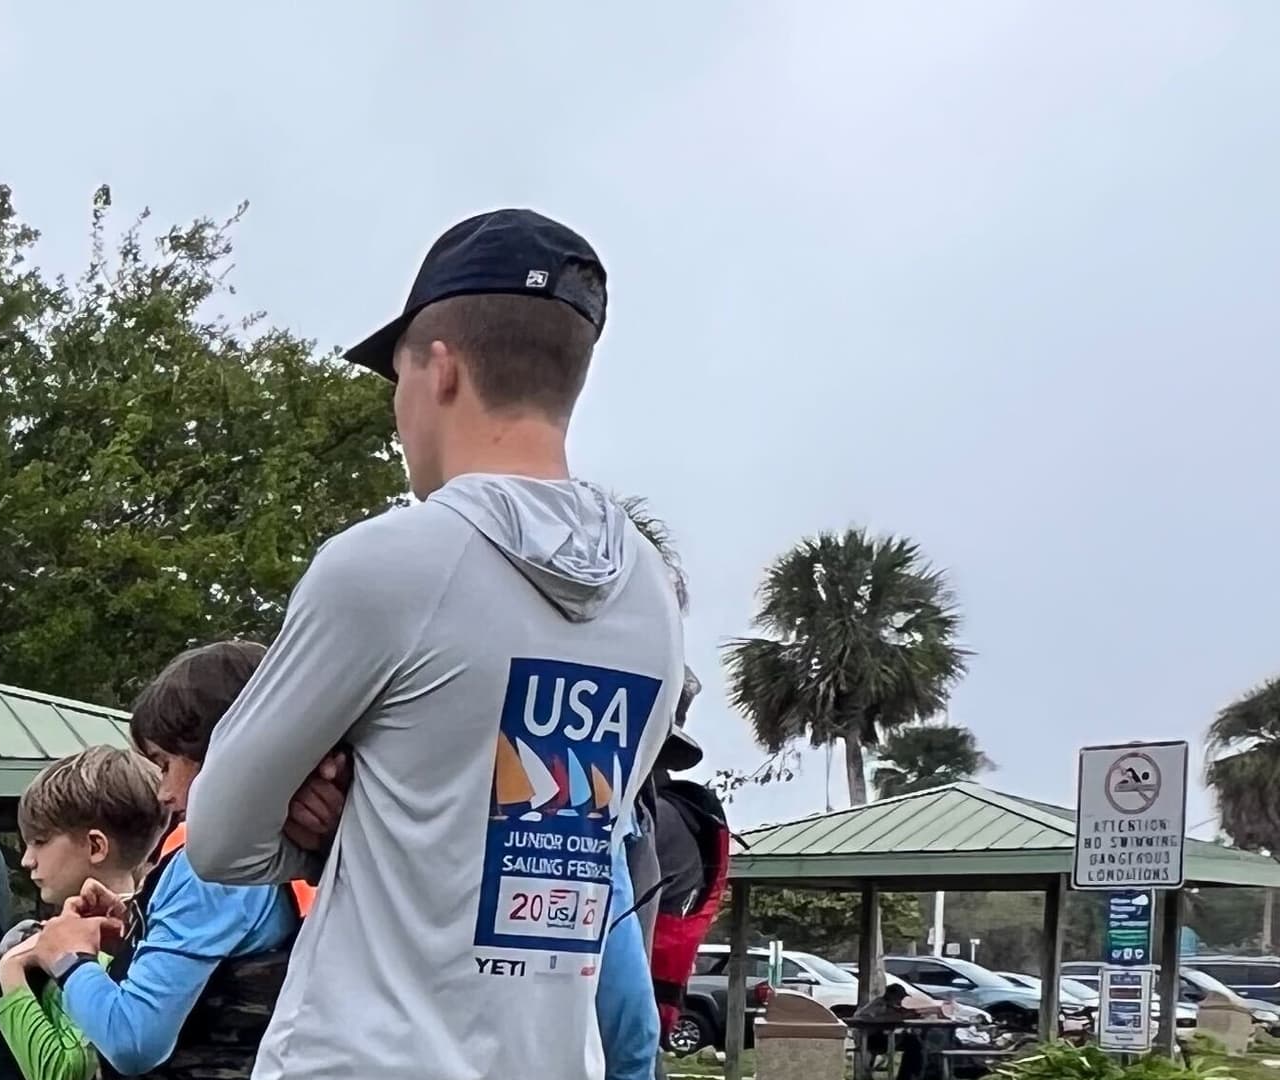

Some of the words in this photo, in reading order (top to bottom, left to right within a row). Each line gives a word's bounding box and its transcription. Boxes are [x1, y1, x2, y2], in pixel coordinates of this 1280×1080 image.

[523, 675, 628, 748] USA
[503, 831, 563, 850] JUNIOR
[1083, 836, 1102, 849] NO
[1110, 834, 1178, 849] SWIMMING
[501, 855, 564, 876] SAILING
[1089, 851, 1170, 866] DANGEROUS
[1087, 867, 1169, 882] CONDITIONS
[509, 892, 543, 922] 20
[474, 956, 526, 977] YETI
